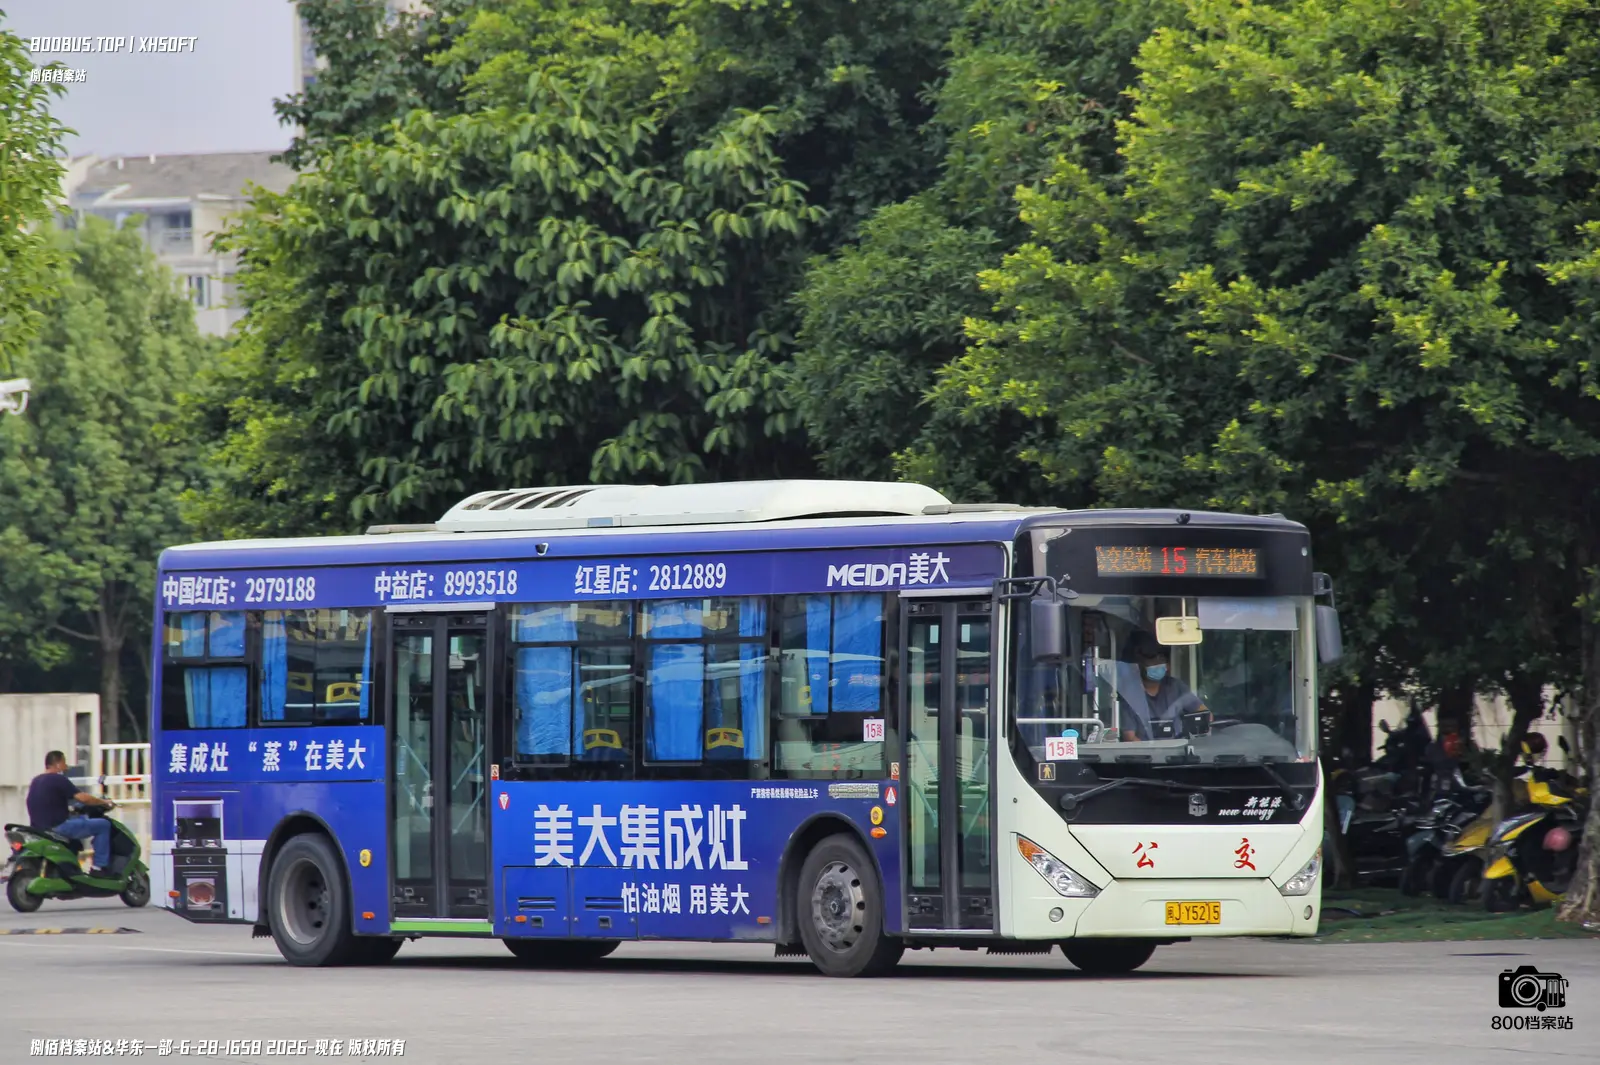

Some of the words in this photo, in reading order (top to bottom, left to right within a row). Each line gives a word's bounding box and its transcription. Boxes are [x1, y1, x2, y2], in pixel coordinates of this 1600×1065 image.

[1160, 547, 1188, 574] 15
[1195, 548, 1257, 574] 汽车北站
[169, 742, 230, 774] 集成灶
[1218, 808, 1241, 816] new
[1242, 808, 1276, 821] energy
[533, 804, 749, 871] 美大集成灶
[621, 882, 682, 914] 怕油烟
[688, 883, 750, 915] 用美大
